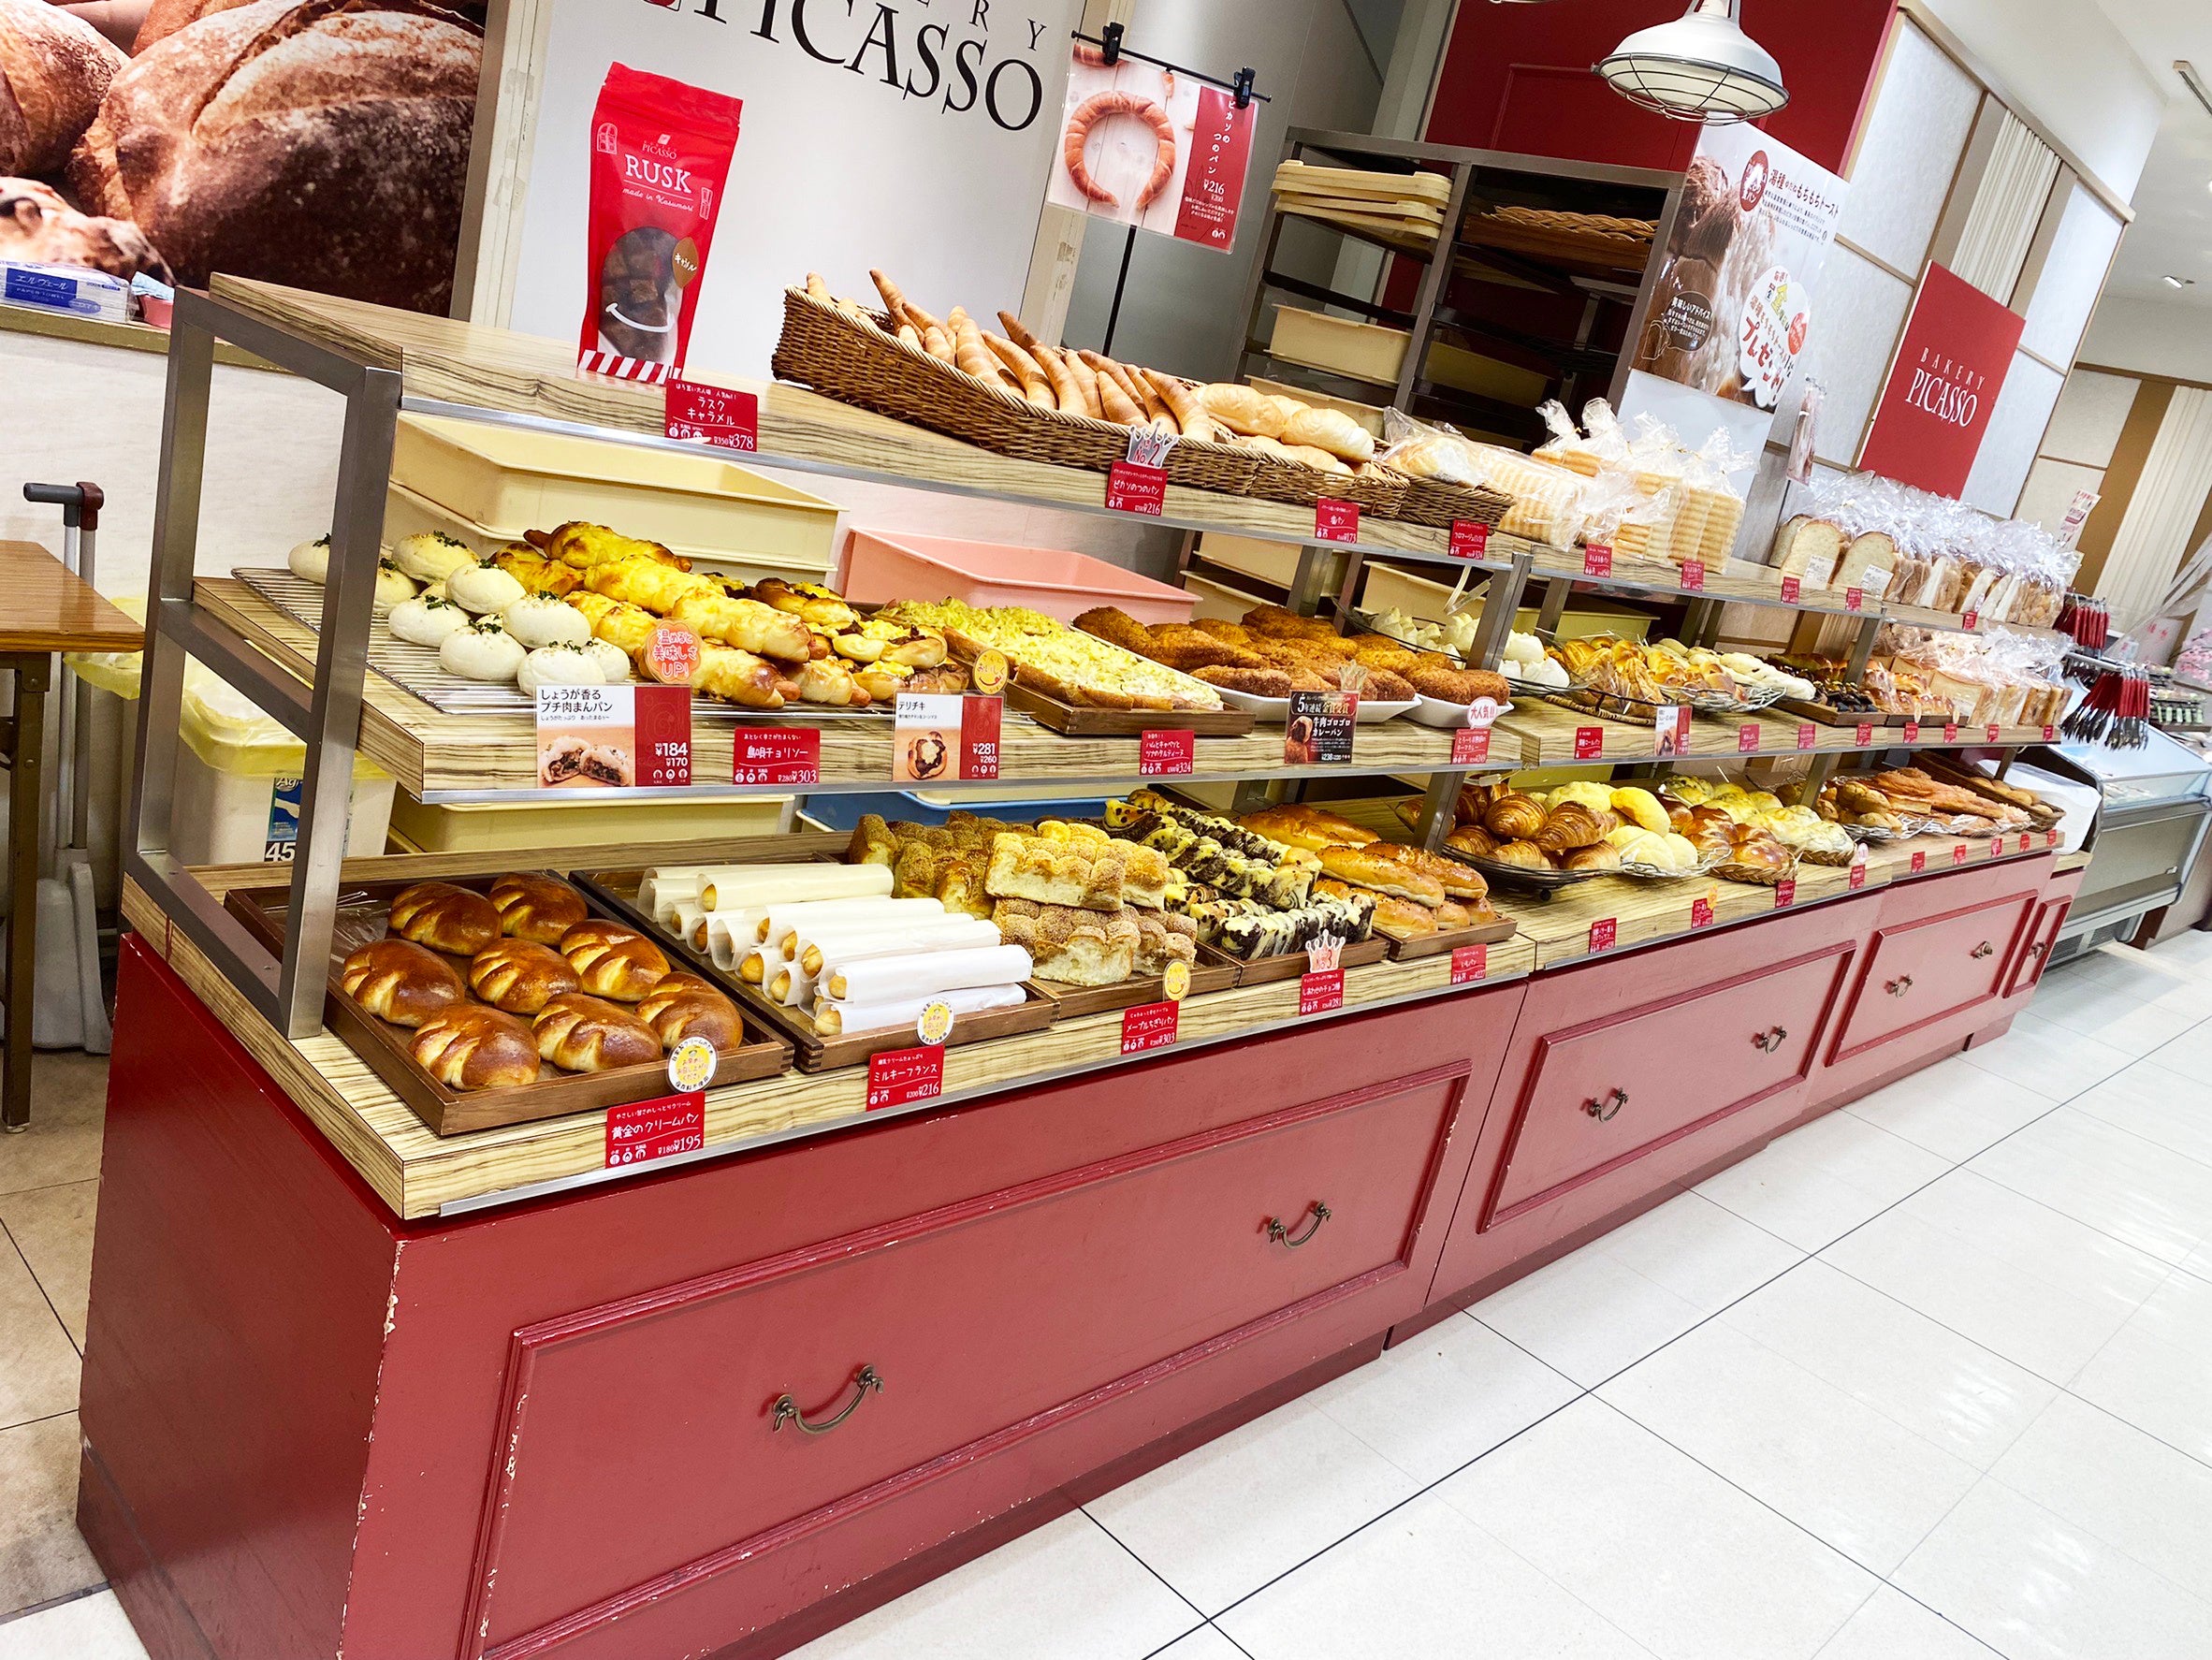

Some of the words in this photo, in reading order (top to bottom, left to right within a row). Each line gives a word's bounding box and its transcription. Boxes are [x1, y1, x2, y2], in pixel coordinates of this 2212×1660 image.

[694, 0, 1042, 131] ICASSO
[642, 142, 677, 160] PICASSO
[1208, 133, 1222, 175] つのパン
[624, 153, 692, 194] RUSK
[622, 188, 644, 198] made
[14, 273, 69, 290] エルヴェール
[1920, 346, 1986, 391] BAKERY
[697, 396, 725, 412] ラスク
[1905, 367, 1978, 428] PICASSO
[687, 407, 735, 426] キャラメル
[729, 433, 754, 449] ¥378
[657, 628, 693, 644] 温めると
[653, 645, 698, 662] 美味しさ
[541, 689, 602, 700] しょうが香る
[541, 702, 613, 713] プチ肉まんパン
[898, 701, 925, 711] テリチキ
[1312, 728, 1343, 737] カレーパン
[655, 742, 688, 757] ¥184
[973, 743, 996, 755] ¥281
[665, 757, 688, 767] ¥170
[265, 842, 296, 861] 45
[874, 1064, 938, 1082] ミルキーフランス
[611, 1112, 700, 1141] 黄金のクリームパン
[674, 1134, 702, 1152] ¥195
